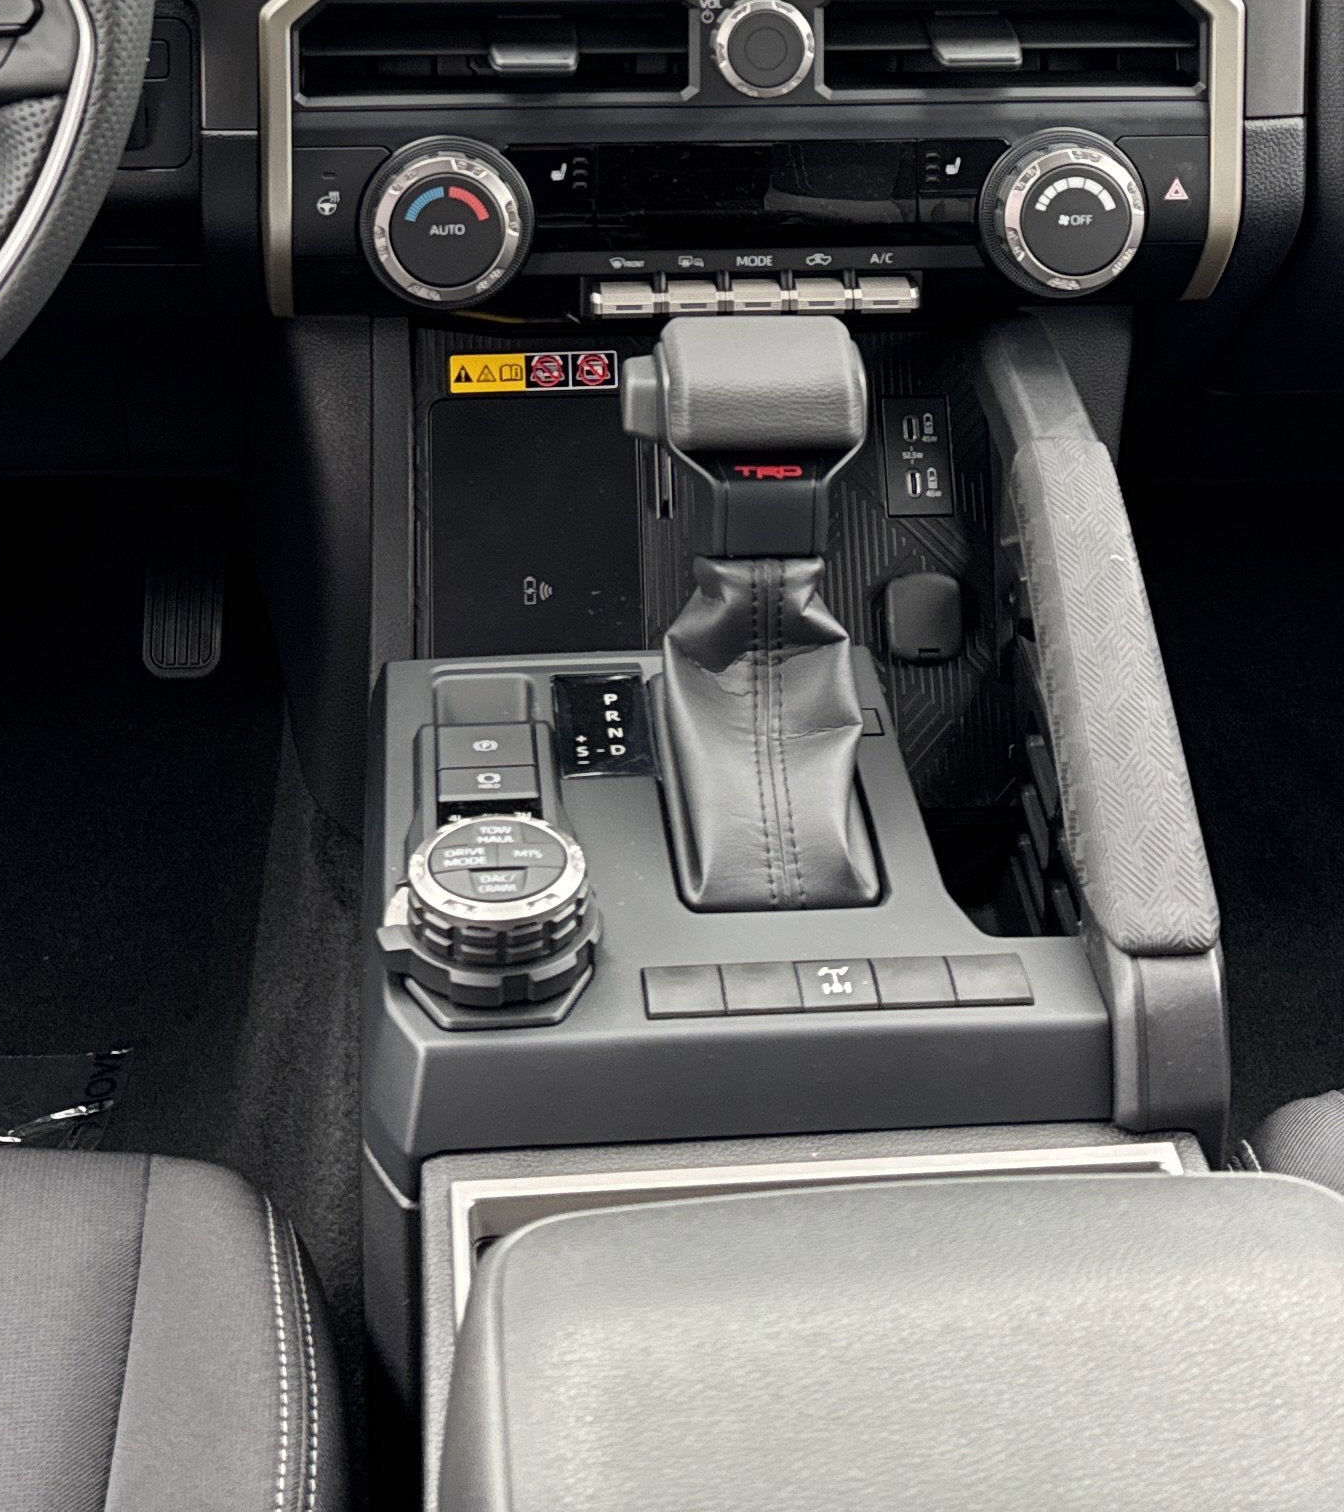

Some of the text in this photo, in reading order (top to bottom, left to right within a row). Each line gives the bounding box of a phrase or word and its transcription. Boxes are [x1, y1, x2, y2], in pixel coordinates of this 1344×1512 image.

[1070, 214, 1094, 226] OFF
[429, 224, 466, 236] AUTO
[735, 255, 774, 267] MODE
[869, 252, 894, 265] A/C
[734, 465, 803, 480] TRD
[603, 693, 618, 706] P
[605, 710, 622, 722] R
[608, 727, 624, 739] N
[479, 825, 513, 834] TOW
[477, 835, 515, 844] HAUL
[443, 847, 486, 858] DRIVE
[443, 856, 487, 868] MODE
